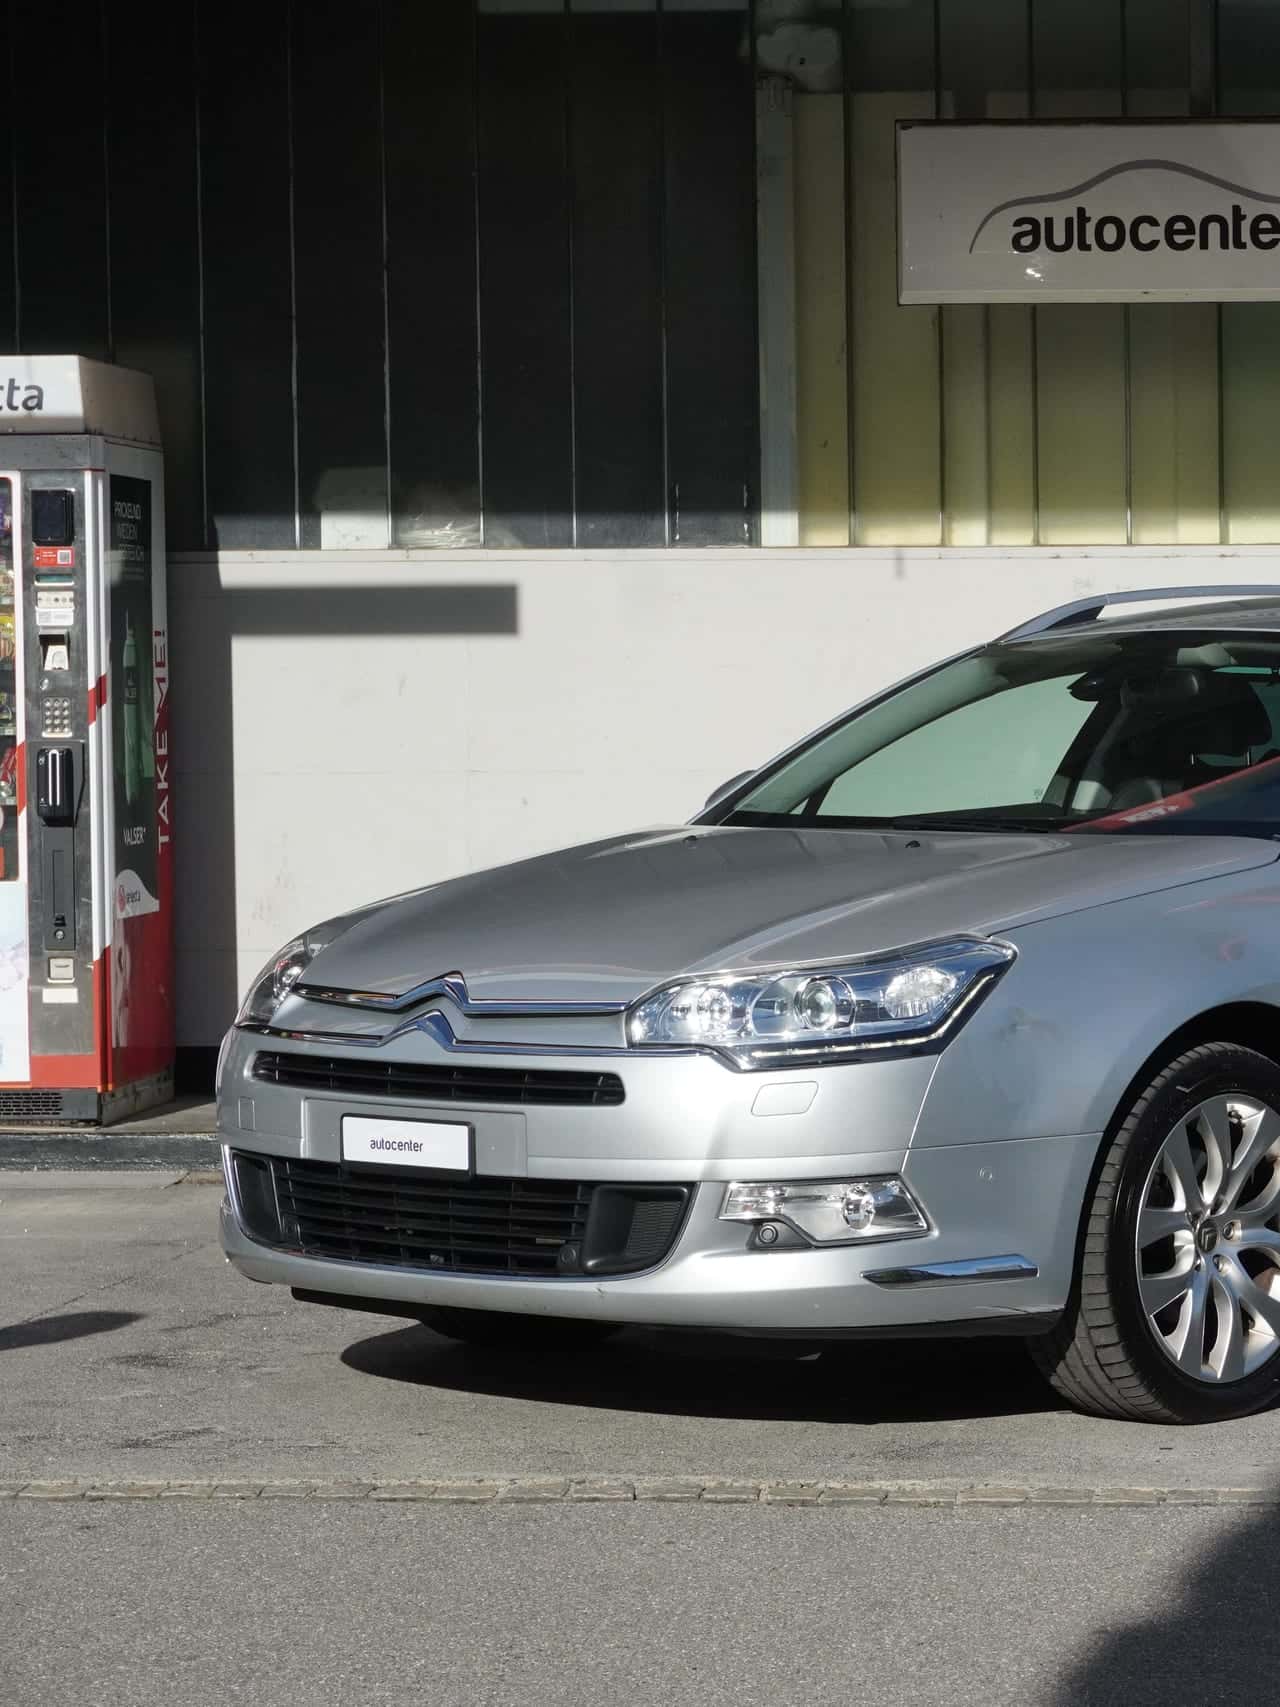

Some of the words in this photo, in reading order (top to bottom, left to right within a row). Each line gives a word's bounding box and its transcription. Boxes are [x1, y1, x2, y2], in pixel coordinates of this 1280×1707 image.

[0, 378, 44, 411] ta
[156, 729, 169, 854] TAKE
[370, 1137, 424, 1152] autocenter
